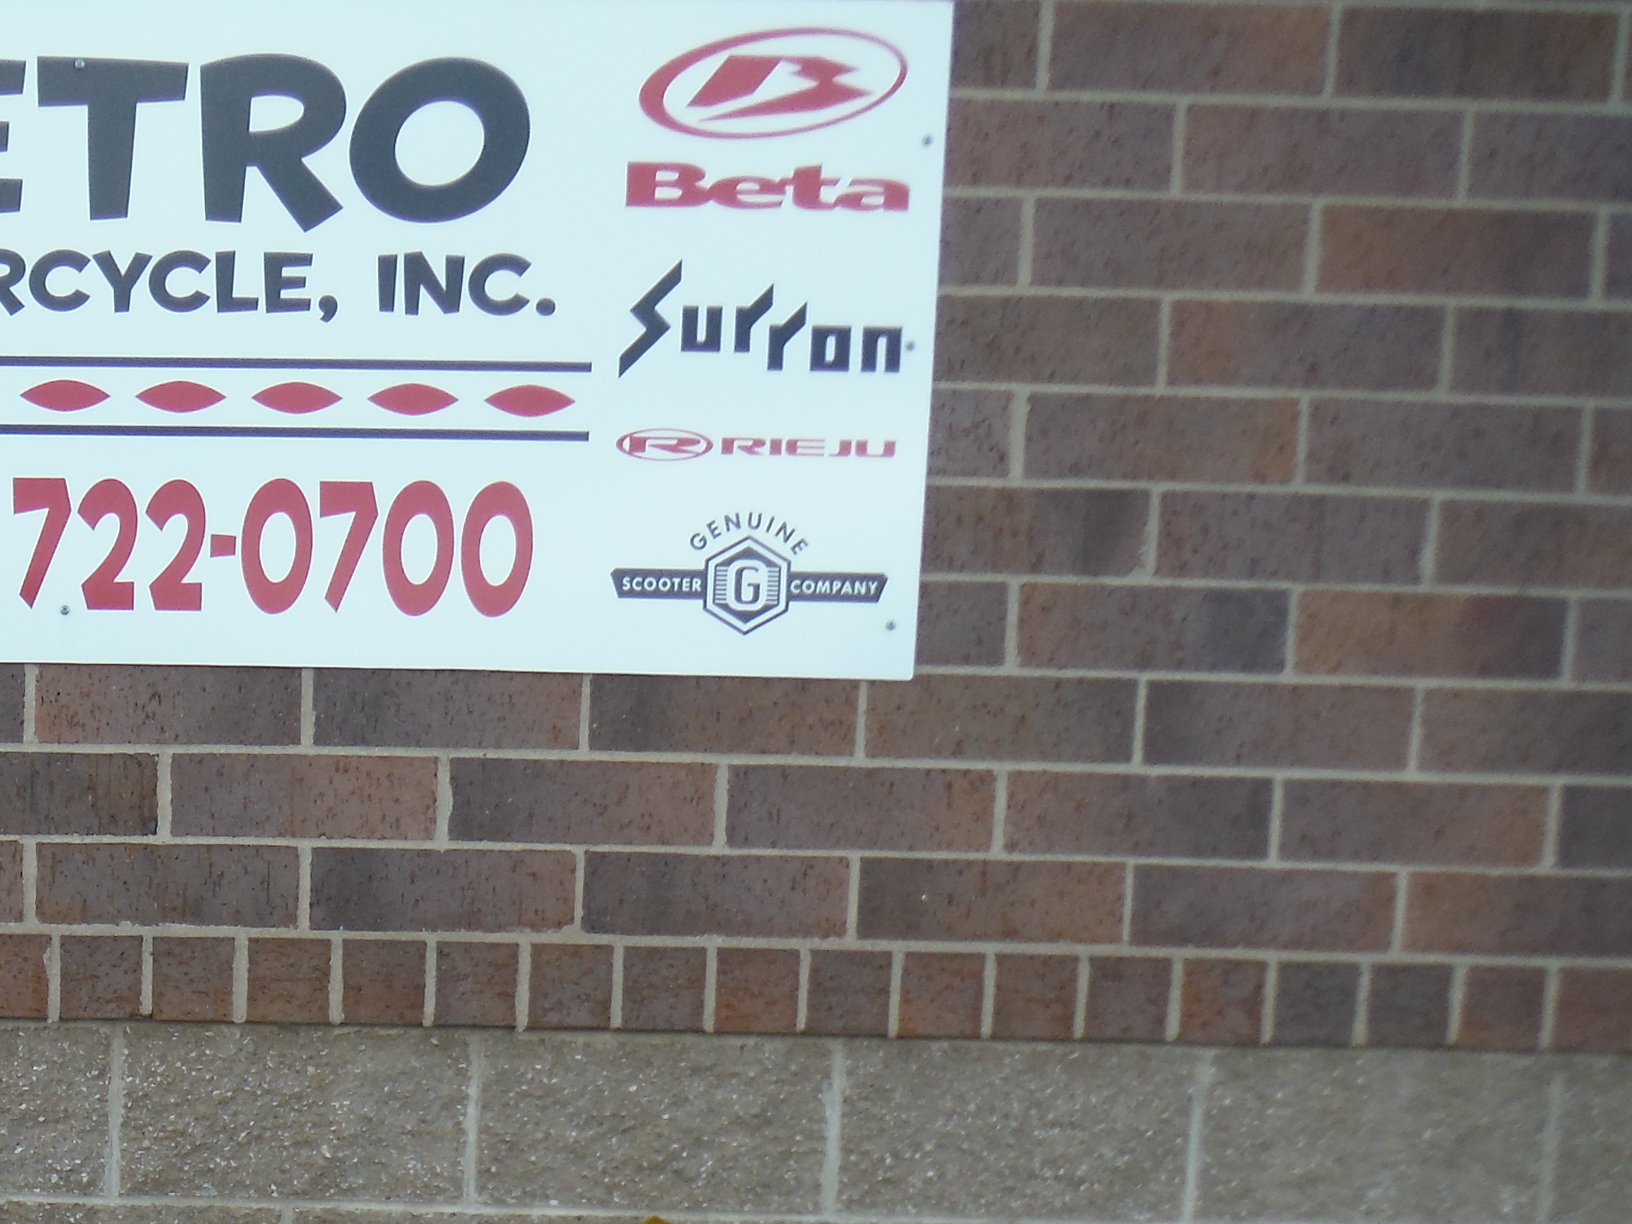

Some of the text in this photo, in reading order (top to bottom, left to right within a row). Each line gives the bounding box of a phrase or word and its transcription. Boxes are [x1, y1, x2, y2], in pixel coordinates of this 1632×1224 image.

[626, 161, 910, 212] Beta
[378, 251, 557, 316] INC.
[618, 258, 903, 379] Surron
[721, 437, 896, 457] RIEJU
[12, 477, 534, 618] 722-0700
[689, 511, 809, 556] GENUINE
[622, 576, 702, 592] SCOOTER
[790, 579, 879, 596] COMPANY
